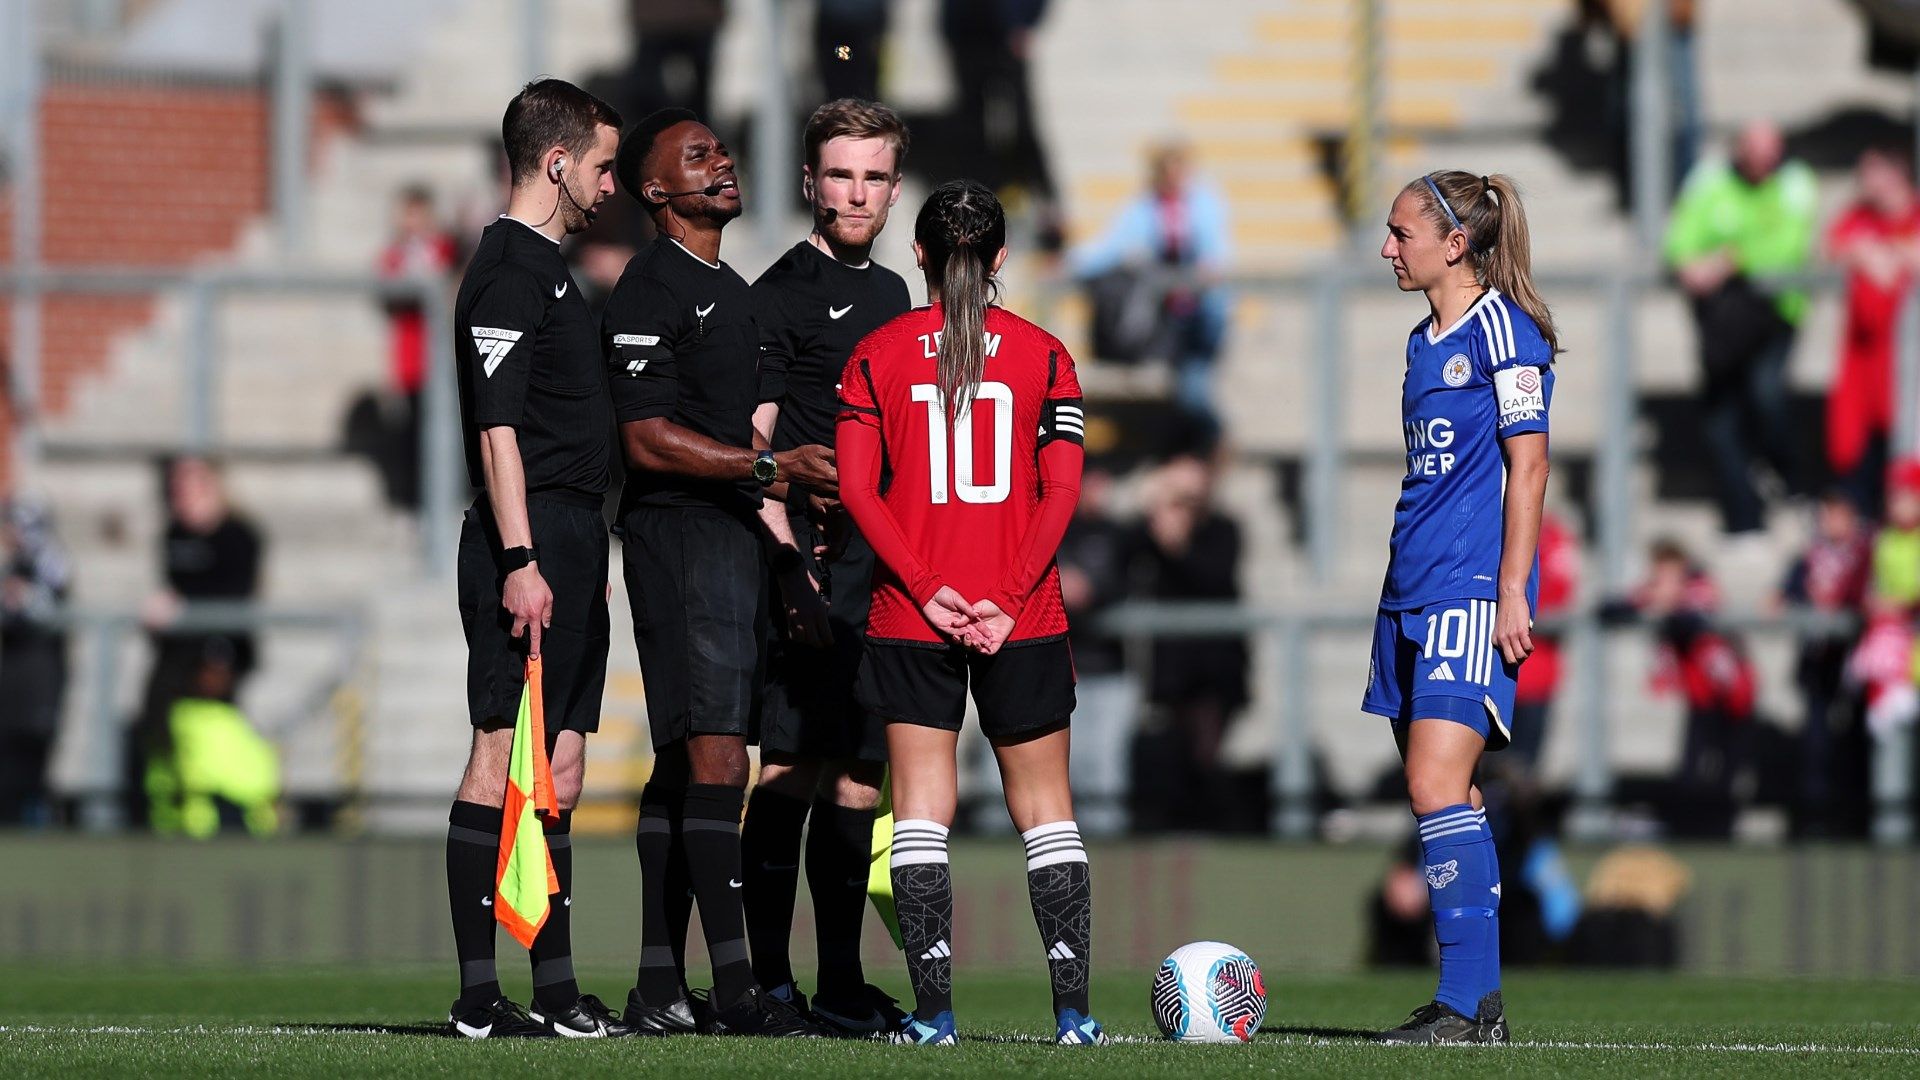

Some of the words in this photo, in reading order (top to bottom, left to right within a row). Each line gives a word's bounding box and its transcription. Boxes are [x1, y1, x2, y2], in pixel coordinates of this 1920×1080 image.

[1503, 396, 1543, 411] CAPTA
[911, 381, 1014, 504] 10
[1406, 417, 1455, 449] ING
[1411, 453, 1456, 475] WER
[1424, 608, 1468, 659] 10
